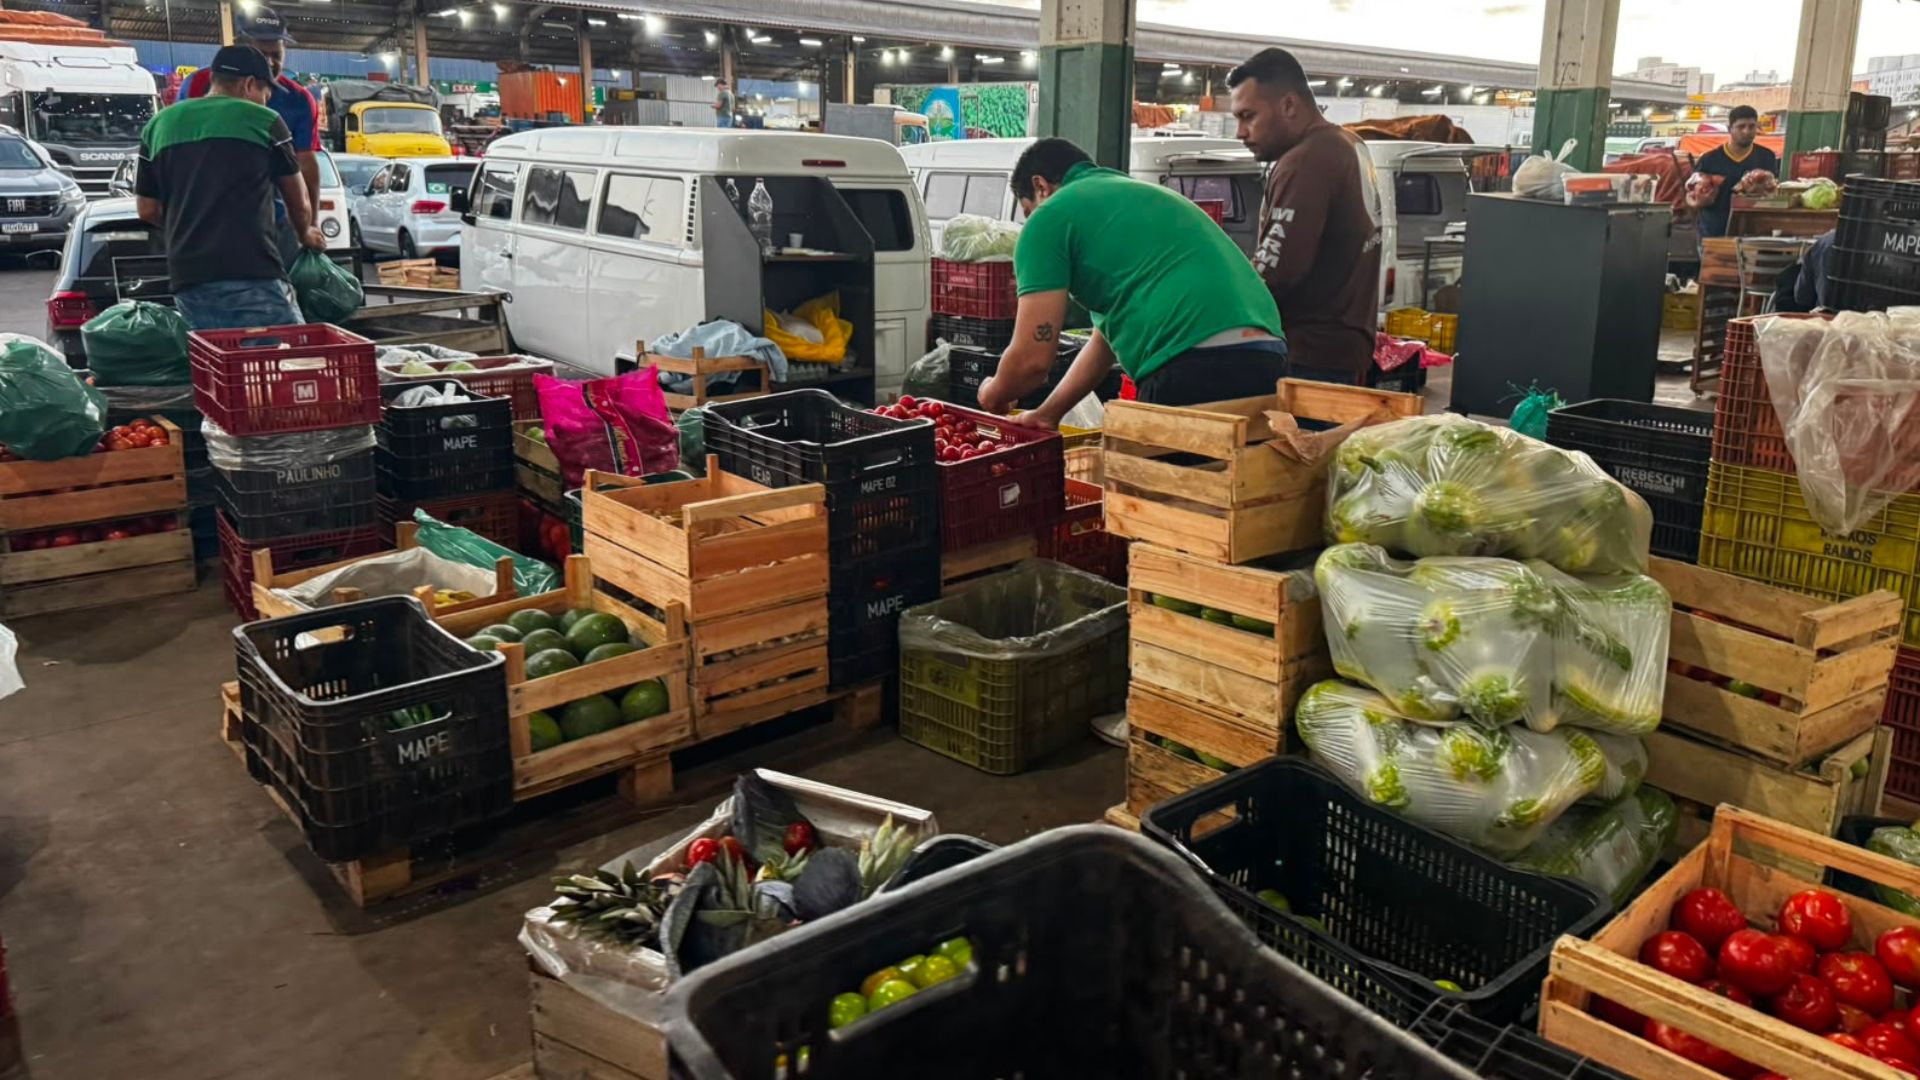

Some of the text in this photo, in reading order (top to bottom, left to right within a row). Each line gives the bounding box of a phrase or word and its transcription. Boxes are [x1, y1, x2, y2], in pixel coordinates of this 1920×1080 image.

[79, 153, 125, 161] SCANIA
[7, 199, 26, 212] FIAT
[442, 434, 478, 451] MAPE
[276, 464, 341, 484] PAULINHO
[1614, 465, 1685, 490] TREBESCHI
[860, 478, 884, 495] MAPE
[1823, 542, 1873, 564] RAMOS
[867, 595, 904, 619] MAPE
[397, 731, 449, 765] MAPE
